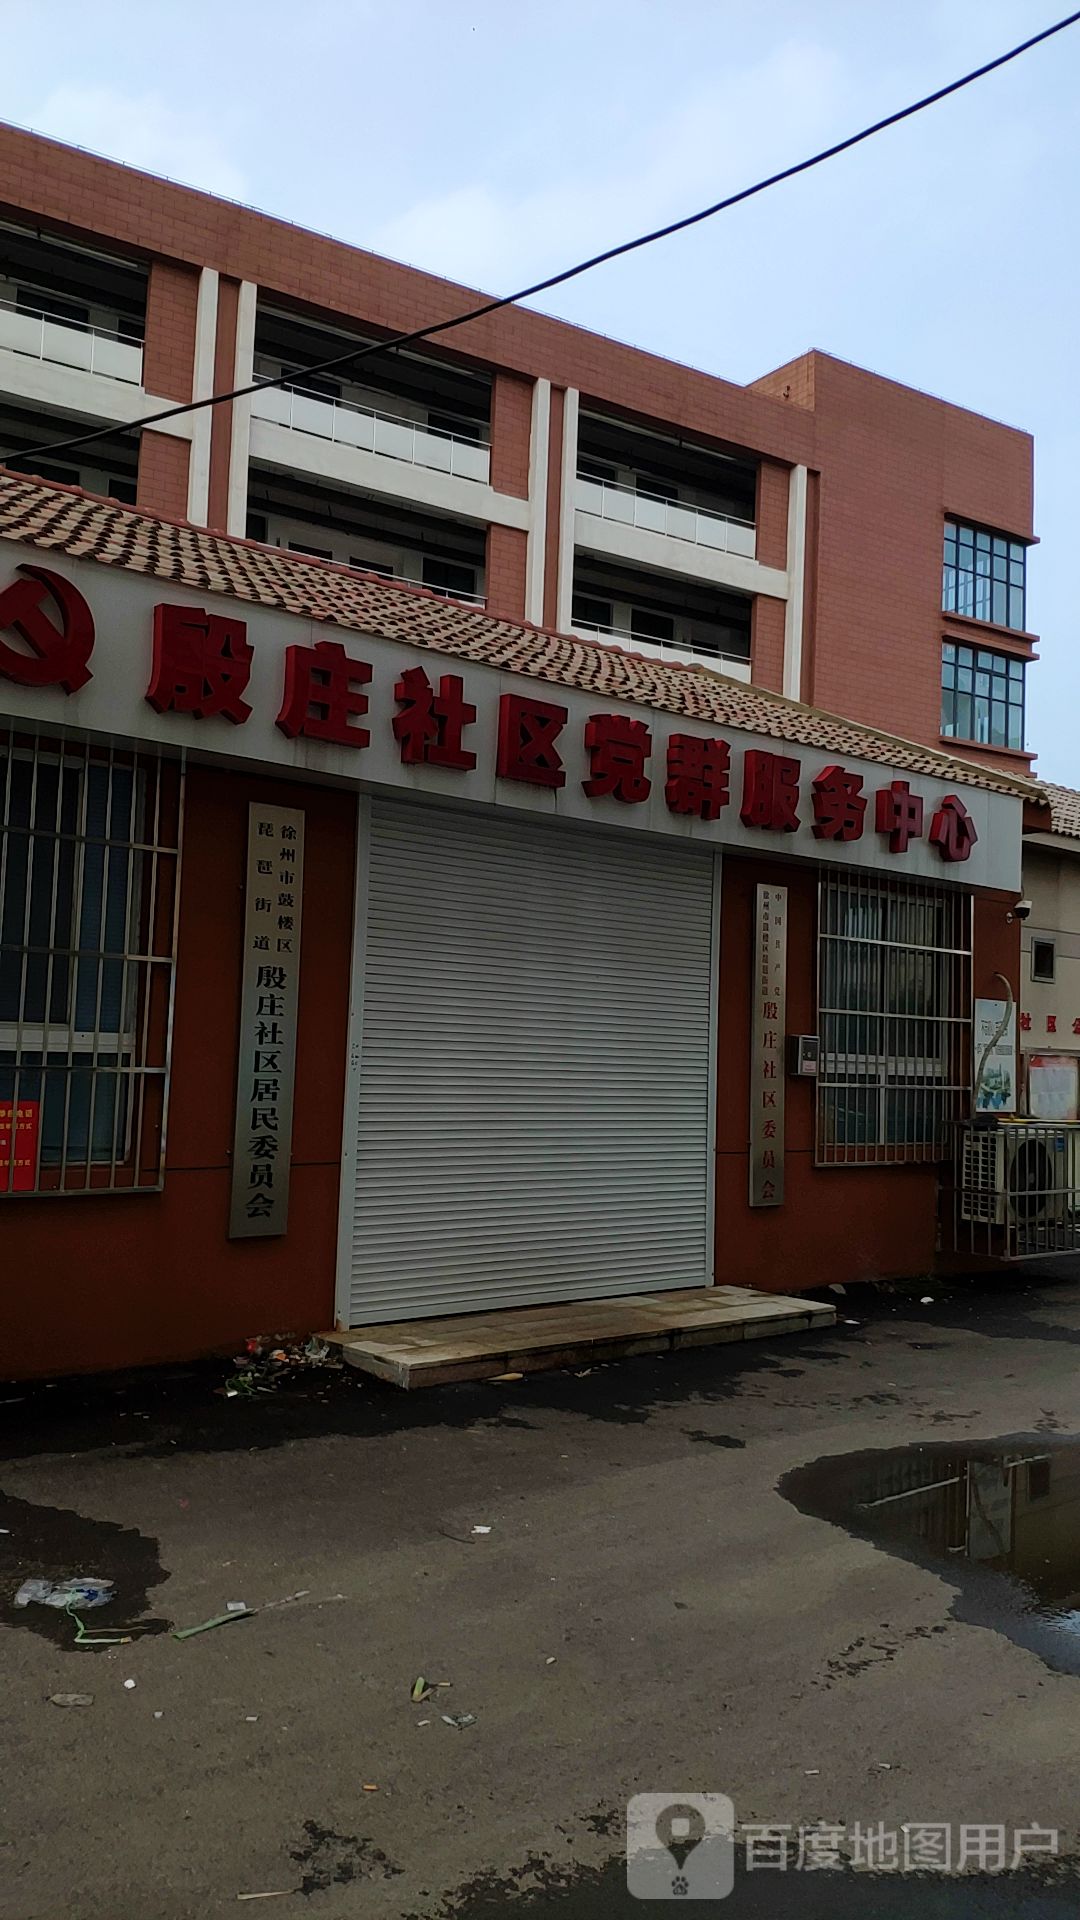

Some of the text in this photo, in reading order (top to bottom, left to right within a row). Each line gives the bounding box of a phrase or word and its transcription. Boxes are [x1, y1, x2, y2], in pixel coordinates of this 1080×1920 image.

[145, 602, 978, 862] 殷庄社区党群服务中心
[253, 821, 274, 950] 琵琶街道
[276, 824, 298, 954] 徐州市鼓楼区
[245, 965, 287, 1218] 殷庄社区居民委员会
[761, 1001, 779, 1200] 殷庄社区委员会
